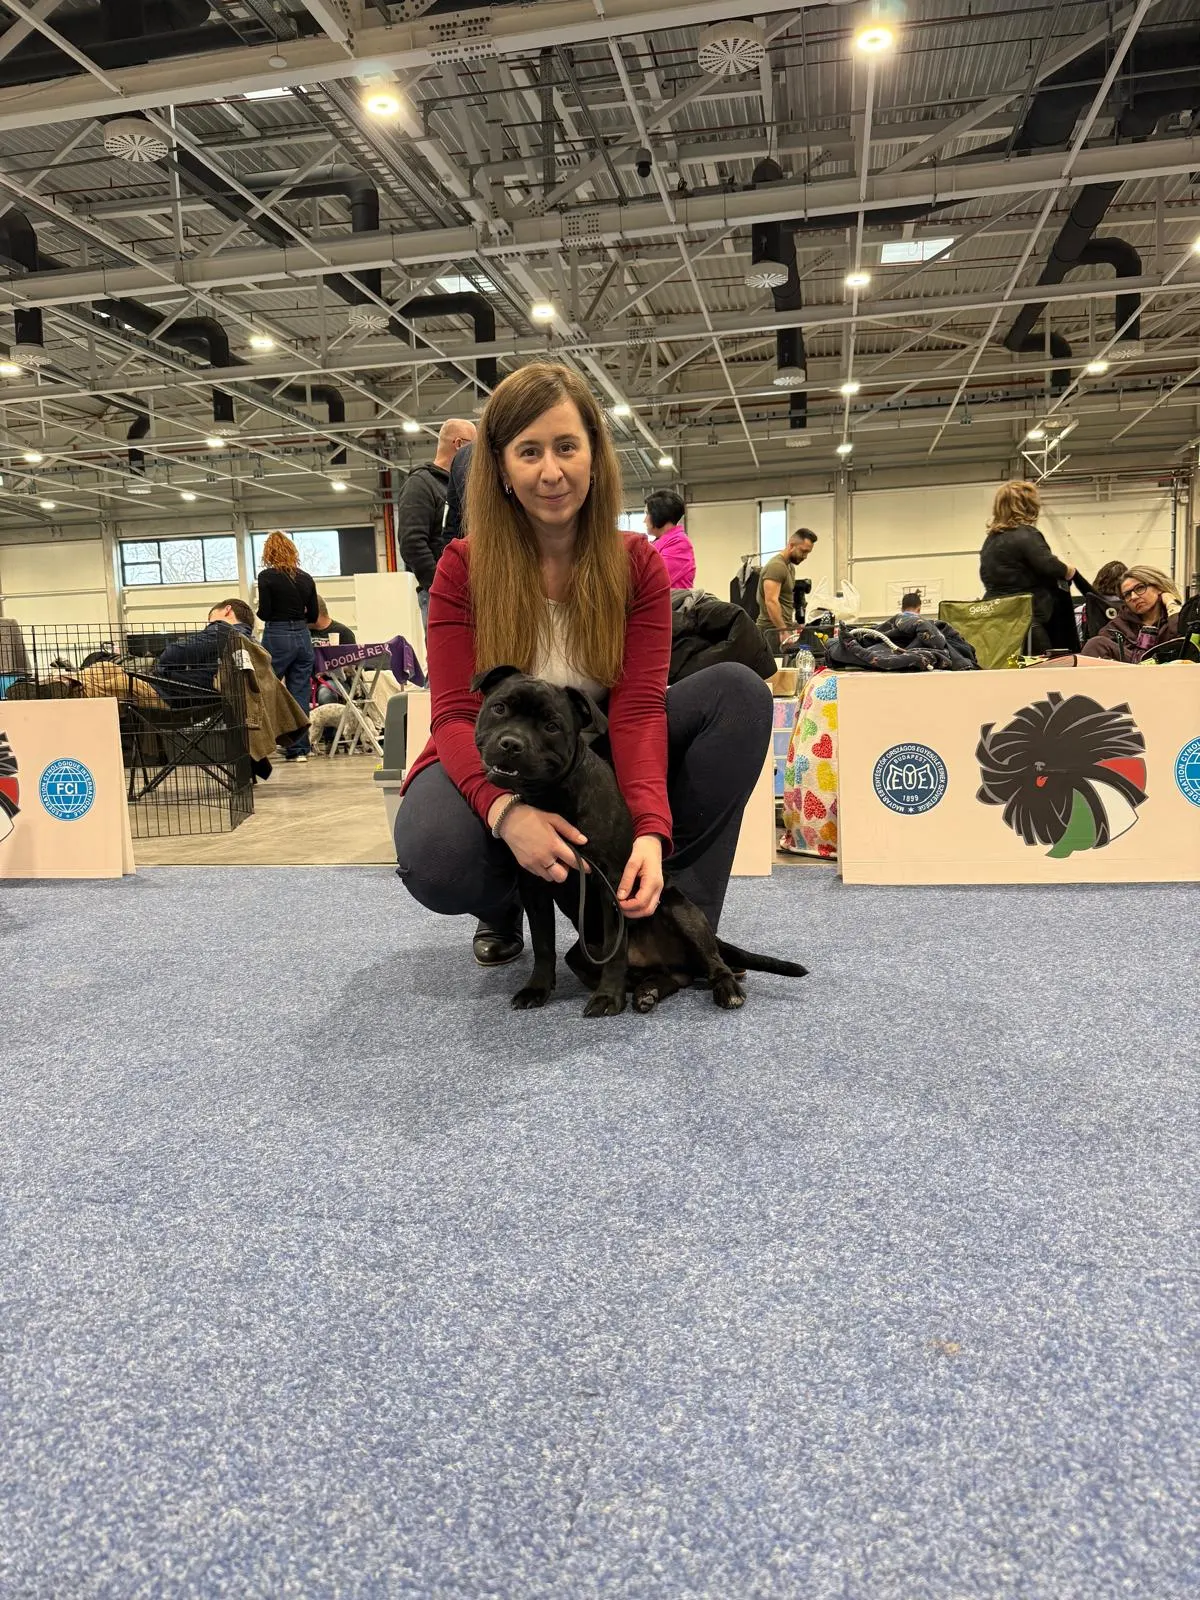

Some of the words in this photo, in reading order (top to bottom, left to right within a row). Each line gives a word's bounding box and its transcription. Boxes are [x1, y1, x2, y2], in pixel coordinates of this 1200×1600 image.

[324, 649, 366, 671] POODLE
[894, 754, 927, 764] BUDAPEST
[43, 761, 80, 781] CYNOLOGIQUE
[74, 768, 92, 817] INTERNATIONALE
[56, 782, 78, 795] FCI
[882, 795, 904, 812] MAGYAR
